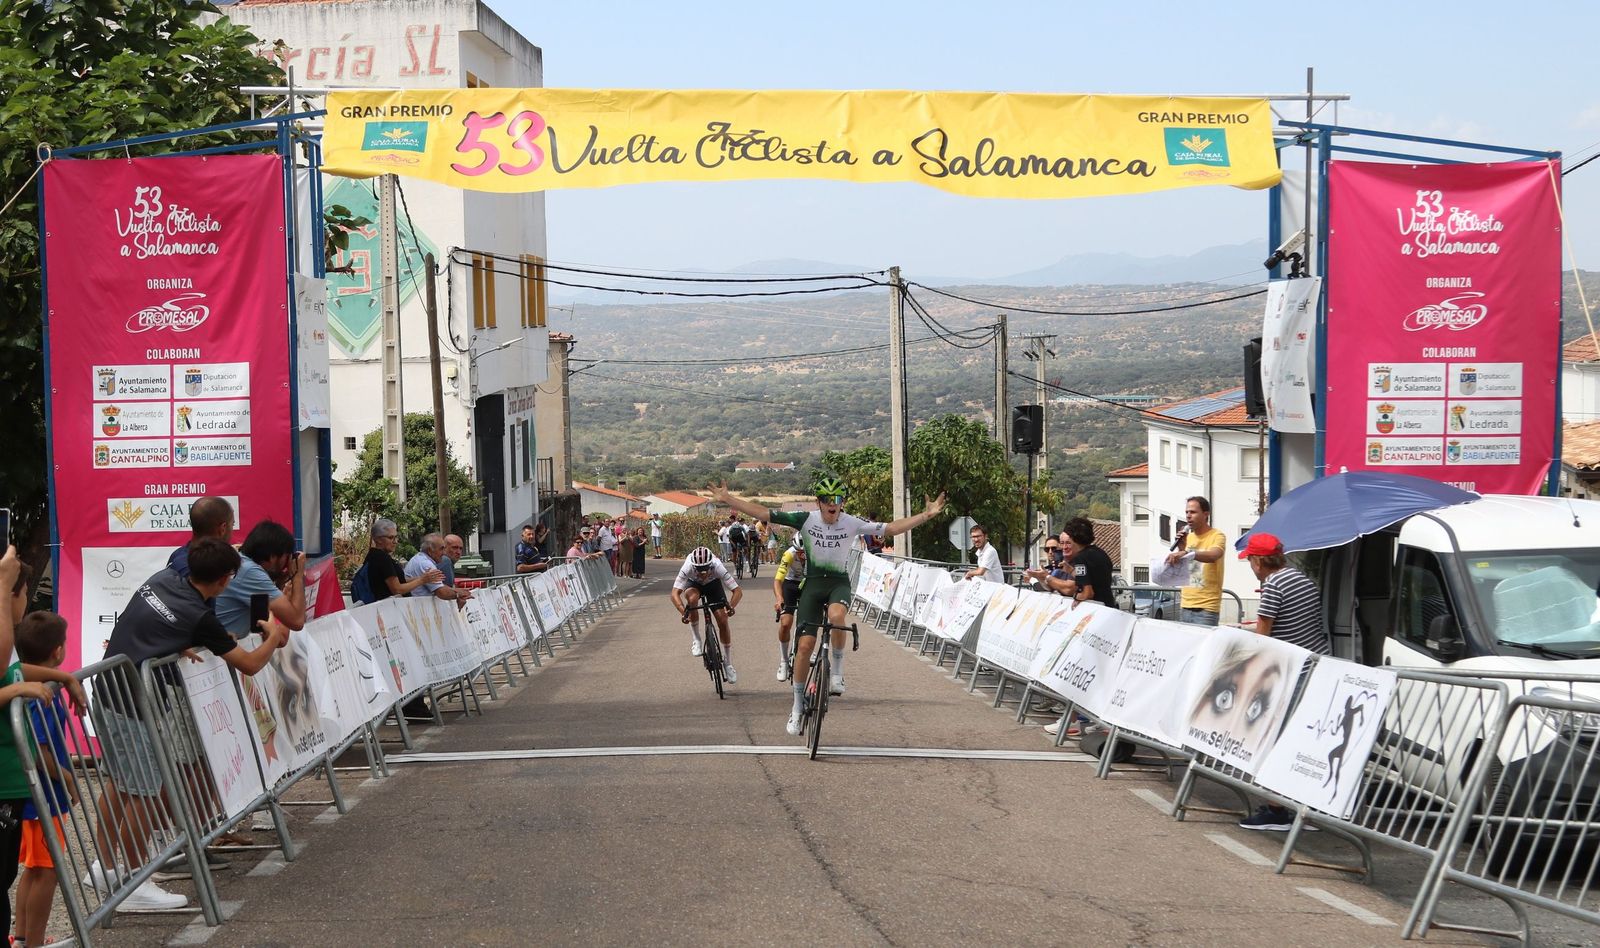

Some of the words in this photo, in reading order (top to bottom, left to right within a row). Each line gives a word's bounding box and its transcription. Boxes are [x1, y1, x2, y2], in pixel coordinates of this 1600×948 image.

[261, 32, 376, 81] rcía
[341, 105, 386, 119] GRAN
[390, 104, 453, 117] PREMIO
[1137, 111, 1183, 123] GRAN
[1187, 113, 1249, 124] PREMIO
[450, 110, 546, 177] 53
[547, 124, 688, 174] Vuelta
[695, 124, 858, 168] Ciclista
[872, 149, 902, 166] a
[911, 128, 1157, 179] Salamanca
[134, 186, 163, 218] 53
[1416, 189, 1445, 218] 53
[114, 207, 165, 237] Vuelta
[166, 206, 222, 236] Ciclista
[1396, 207, 1447, 235] Vuelta
[1447, 209, 1504, 235] Ciclista
[120, 244, 132, 257] a
[133, 232, 220, 260] Salamanca
[1401, 242, 1414, 255] a
[1415, 231, 1501, 258] Salamanca
[147, 277, 193, 290] ORGANIZA
[1426, 277, 1472, 289] ORGANIZA
[138, 310, 201, 326] PROMESAL
[1416, 309, 1478, 325] PROMESAL
[146, 348, 201, 360] COLABORAN
[1422, 347, 1477, 358] COLABORAN
[119, 377, 167, 386] Ayuntamiento
[1394, 375, 1442, 384] Ayuntamiento
[129, 386, 167, 394] Salamanca
[211, 384, 243, 392] Salamanca
[1404, 384, 1442, 392] Salamanca
[196, 409, 240, 417] Ayuntamiento
[129, 423, 148, 431] Alberca
[196, 420, 237, 430] Ledrada
[1469, 419, 1509, 429] Ledrada
[110, 454, 169, 463] CANTALPINO
[190, 453, 251, 461] BABILAFUENTE
[1384, 453, 1442, 461] CANTALPINO
[1462, 451, 1519, 460] BABILAFUENTE
[144, 484, 169, 495] GRAN
[171, 483, 206, 495] PREMIO
[150, 503, 184, 518] CAJA
[150, 519, 164, 528] DE
[808, 529, 824, 539] CAJA
[825, 533, 848, 541] RURAL
[815, 539, 841, 548] ALEA
[1055, 653, 1096, 692] Ledrada
